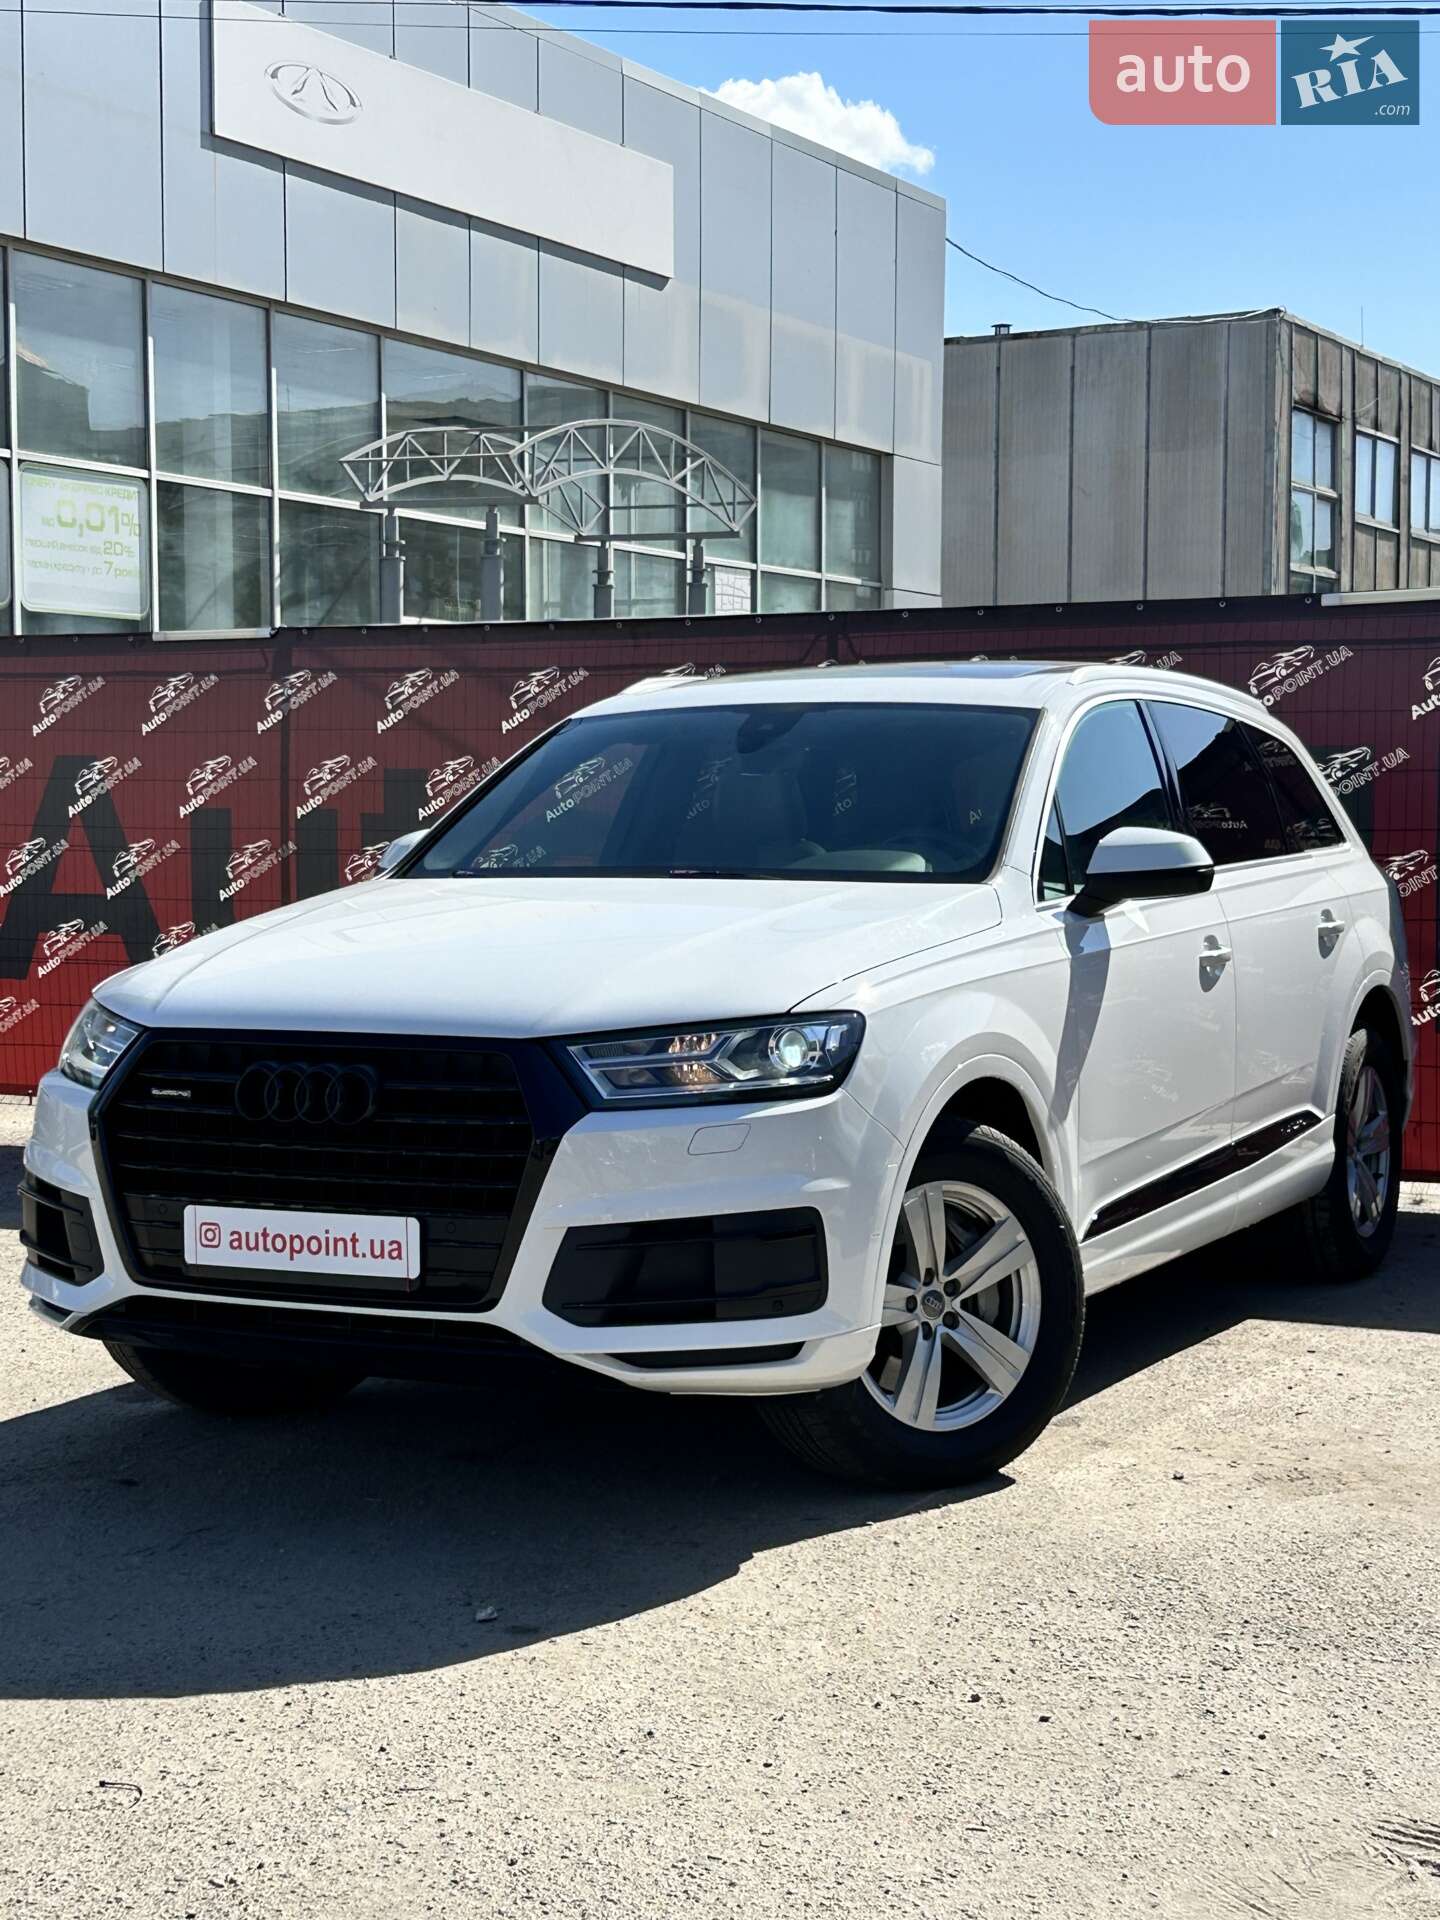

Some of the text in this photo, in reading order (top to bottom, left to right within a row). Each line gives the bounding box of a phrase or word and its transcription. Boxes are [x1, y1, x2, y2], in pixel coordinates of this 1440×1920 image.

[56, 499, 142, 537] 0,01%
[501, 667, 590, 734] AutoPOINT.UA
[1258, 646, 1354, 706] oPOINT.UA
[229, 1227, 403, 1261] autopoint.ua
